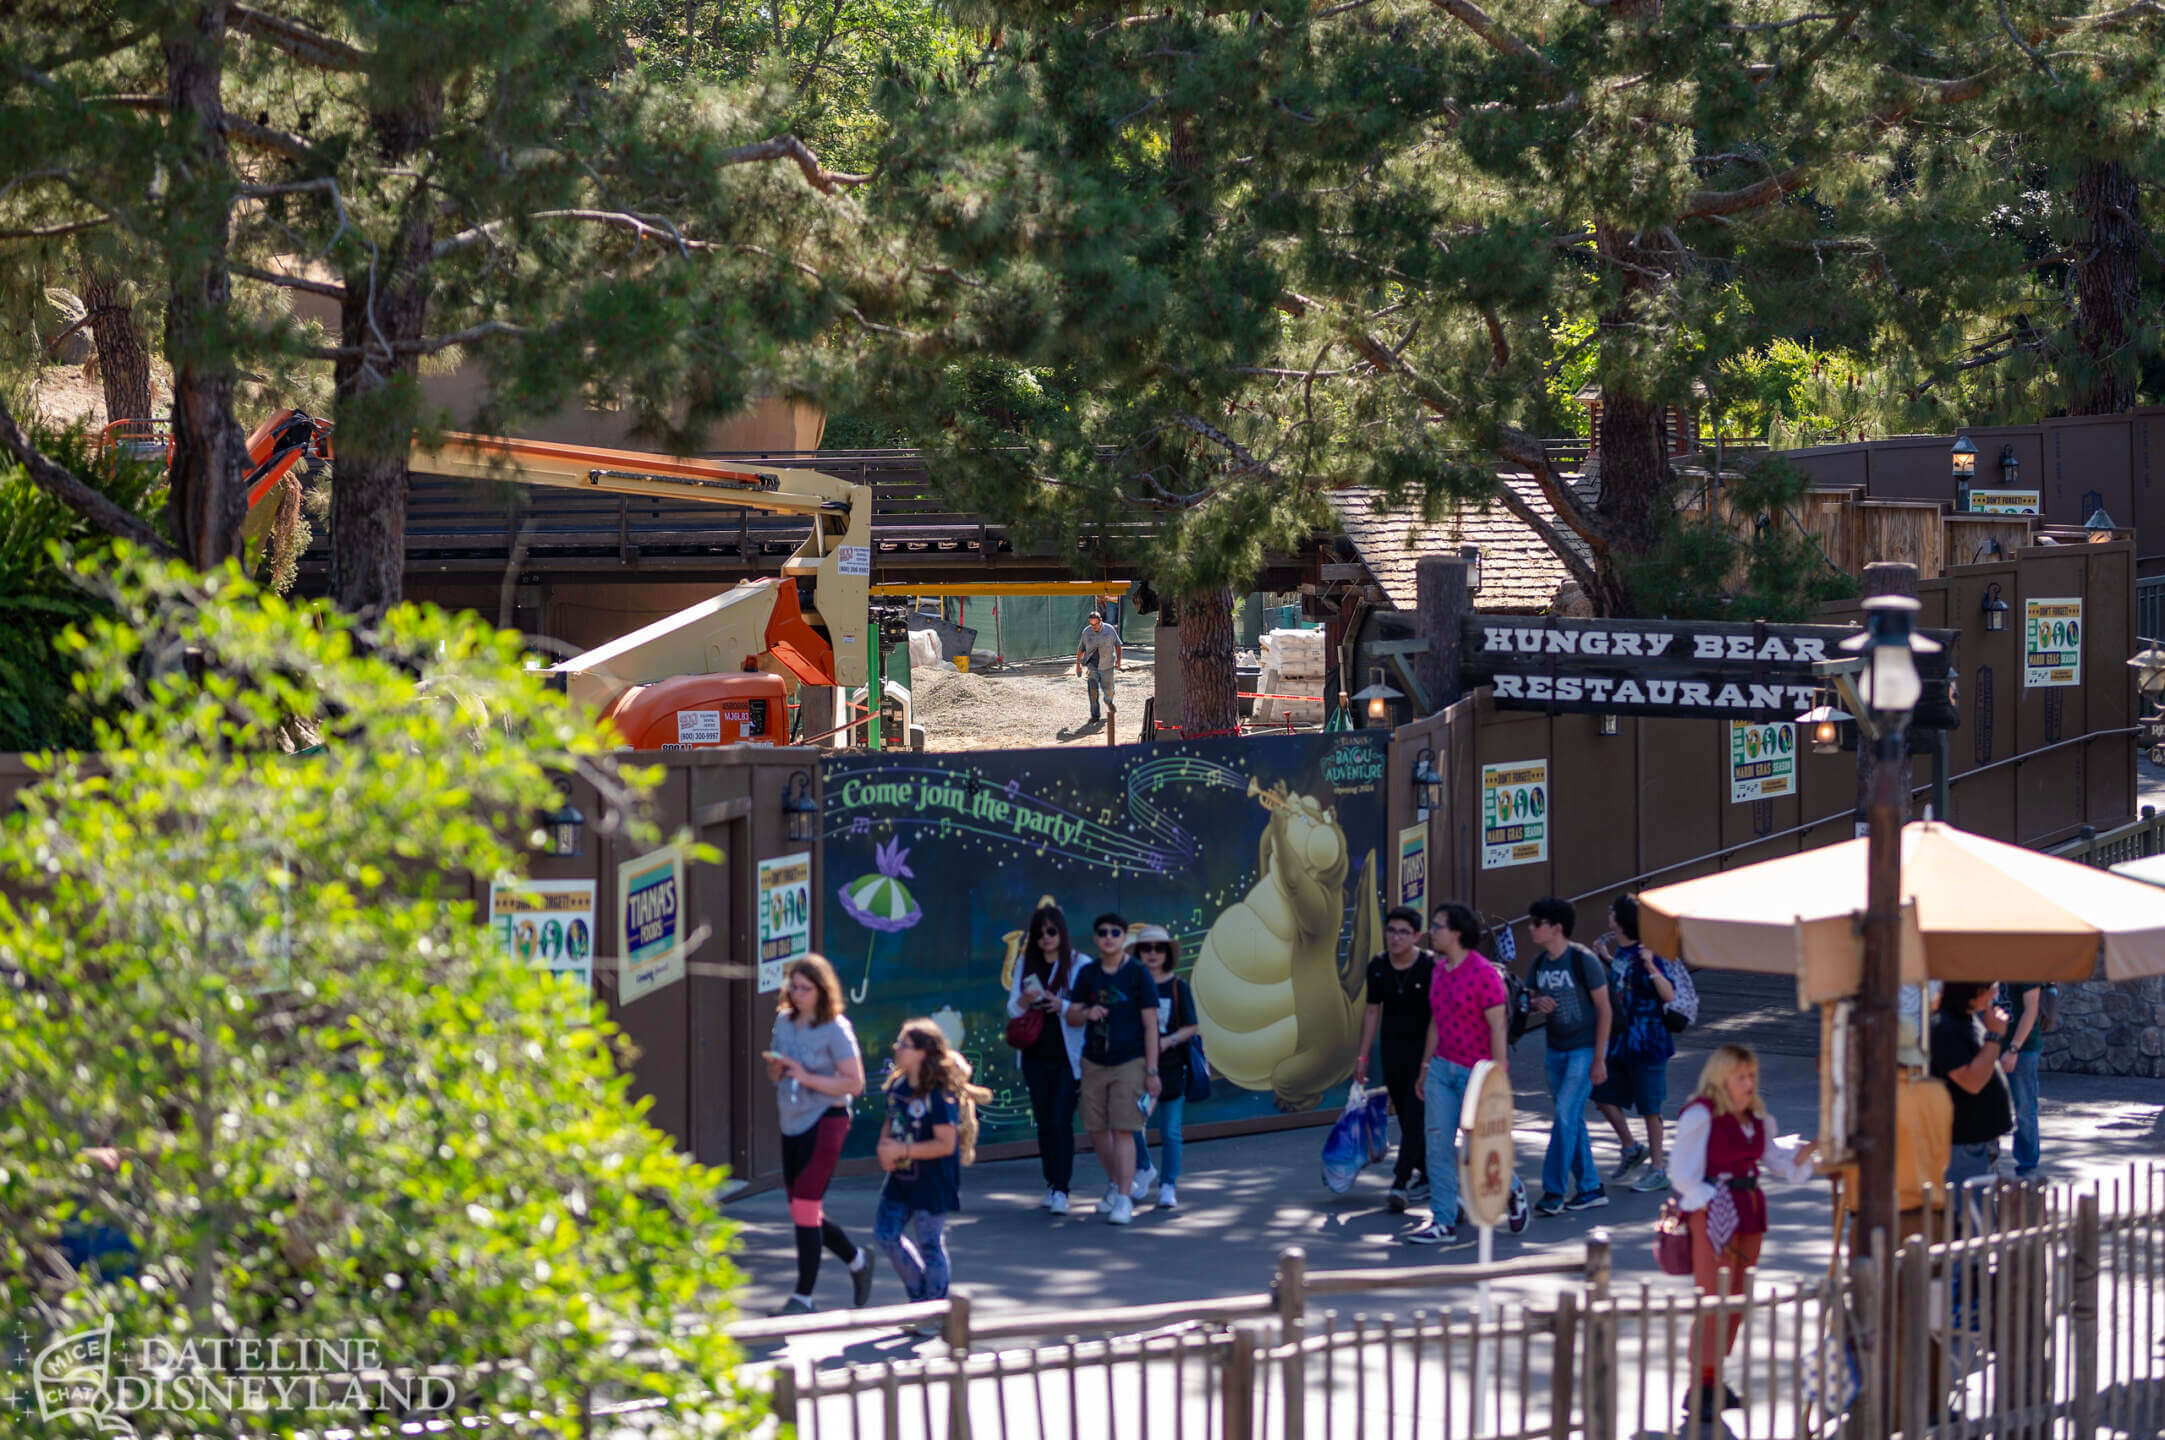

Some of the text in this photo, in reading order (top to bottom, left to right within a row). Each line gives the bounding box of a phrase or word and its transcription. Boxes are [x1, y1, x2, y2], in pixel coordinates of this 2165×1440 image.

[1484, 628, 1827, 661] HUNGRY BEAR
[1493, 674, 1816, 709] RESTAURANT
[1336, 746, 1372, 765] BAYOU
[1325, 765, 1383, 781] ADVENTURE
[842, 777, 1084, 846] Come join the party!
[629, 880, 675, 929] TIANA'S
[640, 919, 663, 944] FOODS
[1536, 970, 1574, 989] NASA
